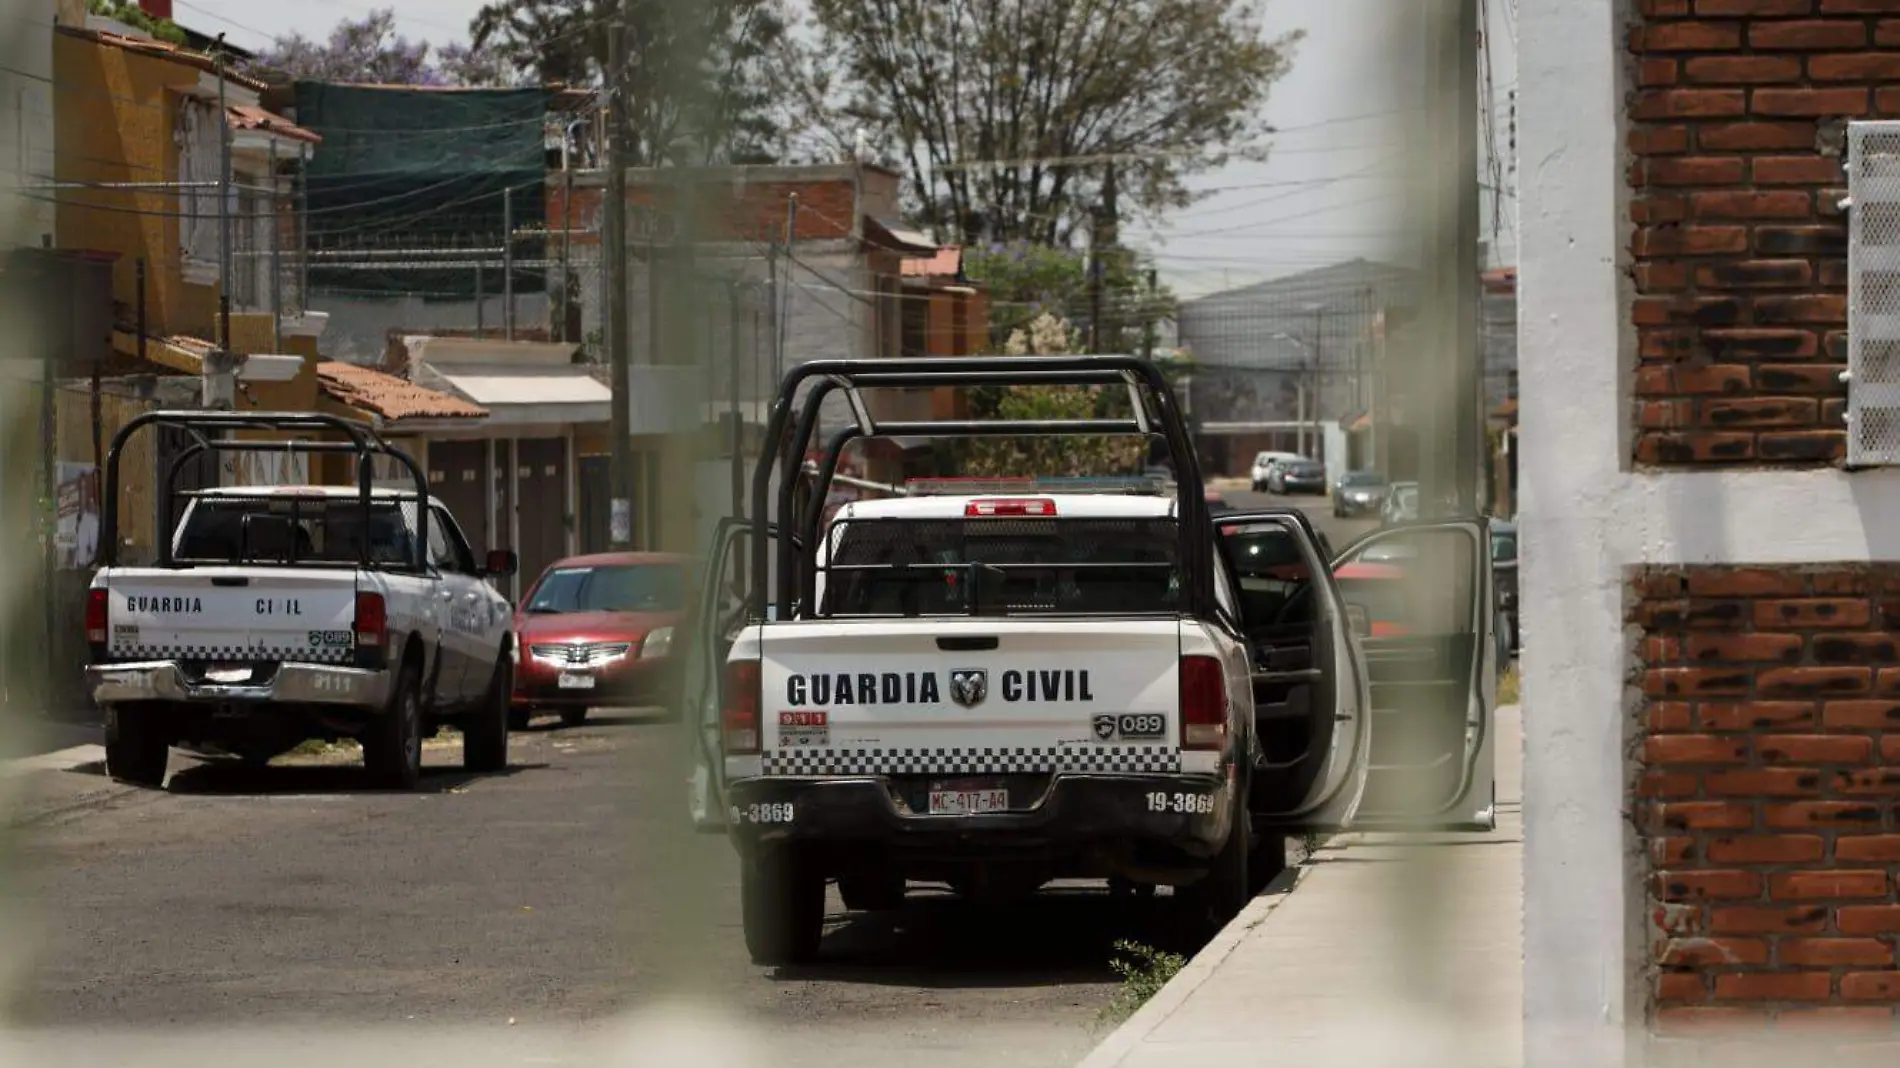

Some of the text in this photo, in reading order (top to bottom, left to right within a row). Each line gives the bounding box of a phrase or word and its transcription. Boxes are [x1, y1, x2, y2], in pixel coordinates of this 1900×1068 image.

[127, 597, 302, 614] GUARDIA CIIL
[787, 670, 1094, 706] GUARDIA CIVIL
[783, 713, 823, 724] 911
[1122, 716, 1161, 732] 089
[1145, 791, 1214, 814] 19-3869
